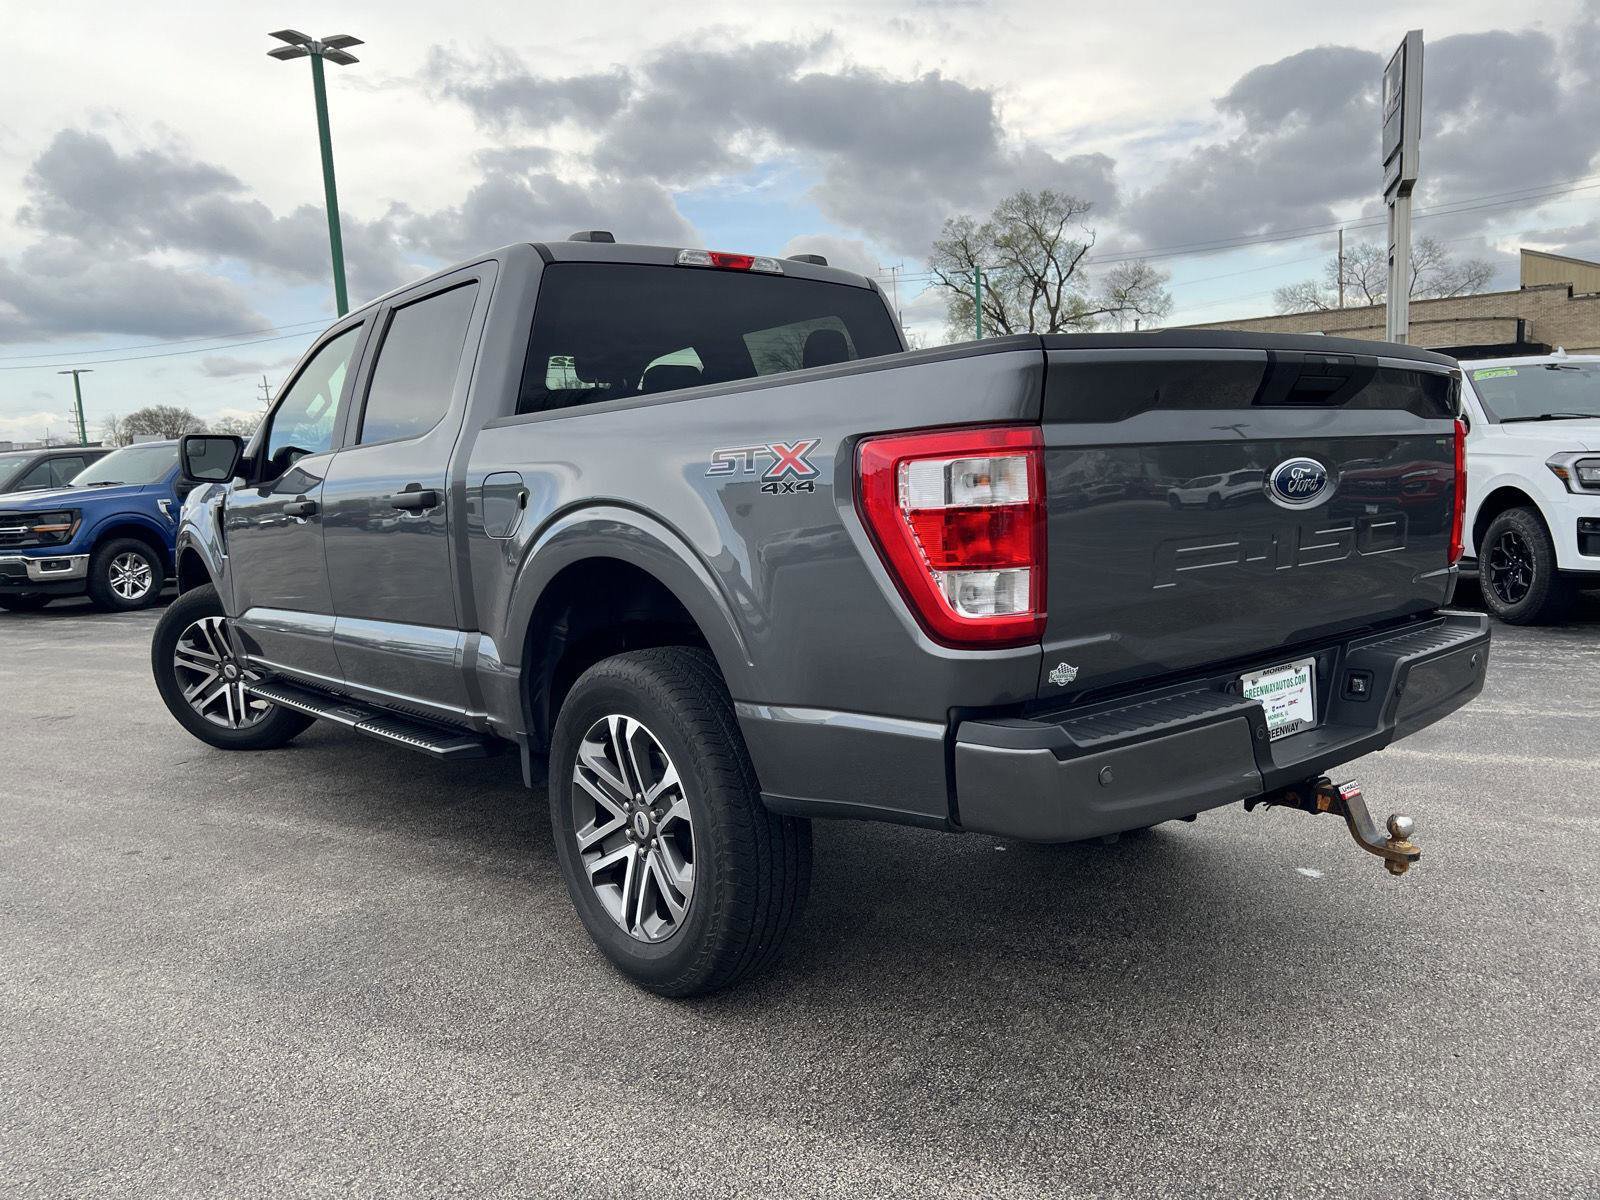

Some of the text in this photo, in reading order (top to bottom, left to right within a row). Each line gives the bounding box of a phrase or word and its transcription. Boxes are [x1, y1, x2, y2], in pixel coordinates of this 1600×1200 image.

[705, 438, 822, 483] STX
[1287, 467, 1319, 493] Ford
[1262, 664, 1293, 676] MORRIS
[1244, 674, 1307, 699] GREENWAYAUTOS.COM
